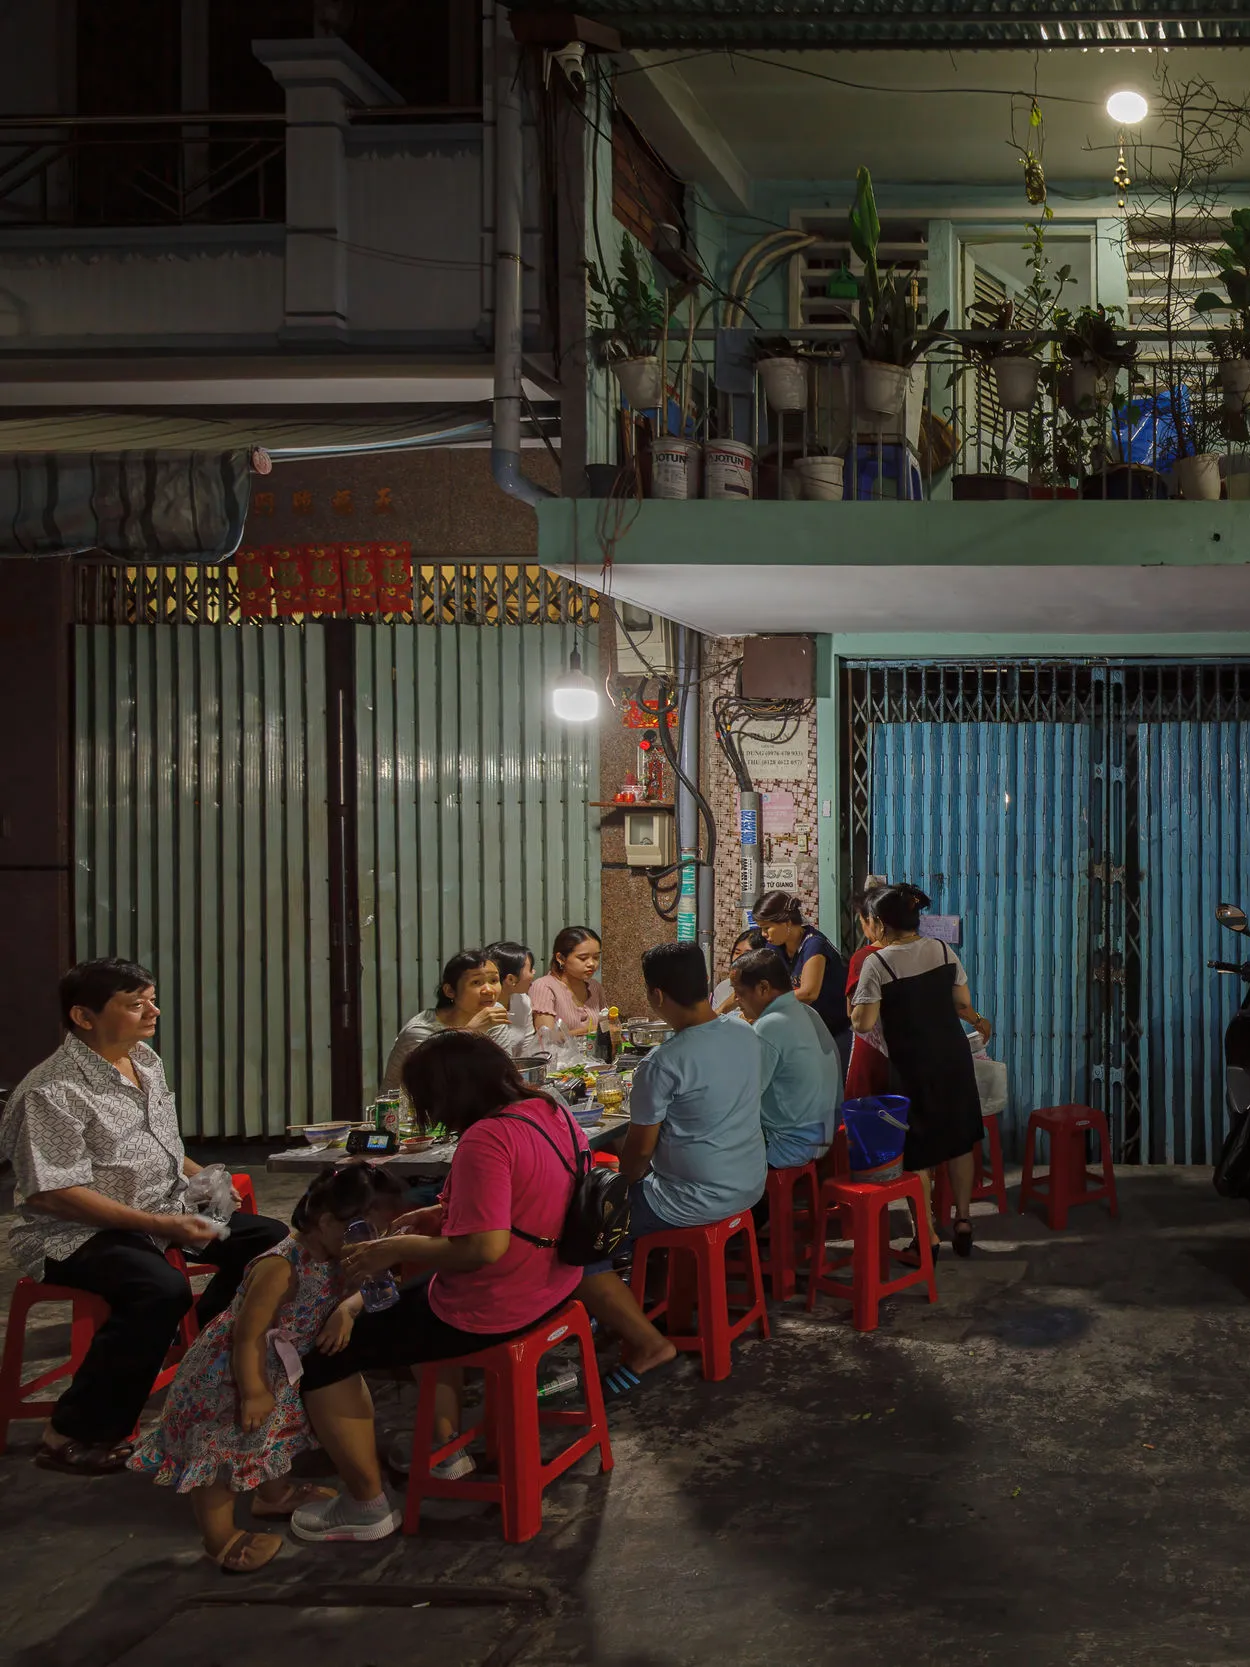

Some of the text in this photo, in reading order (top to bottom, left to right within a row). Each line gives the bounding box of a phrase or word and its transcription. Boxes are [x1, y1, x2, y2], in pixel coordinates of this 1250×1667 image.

[713, 453, 745, 466] JOTUN
[764, 868, 794, 879] 5/3
[776, 881, 794, 889] GIANG
